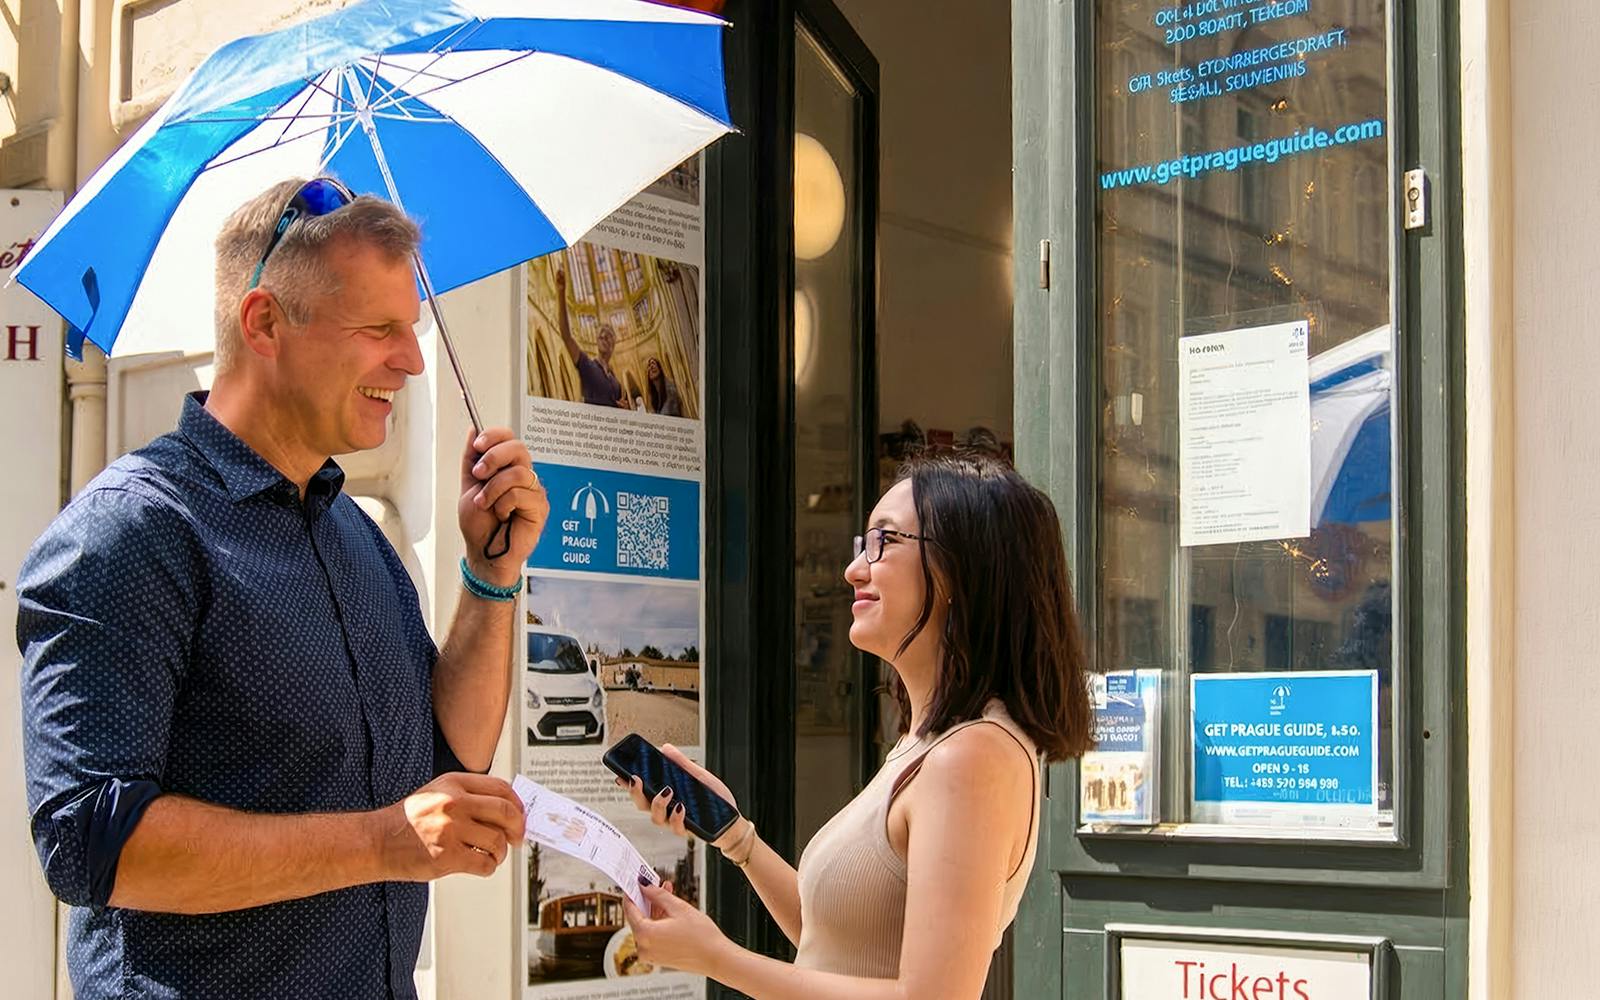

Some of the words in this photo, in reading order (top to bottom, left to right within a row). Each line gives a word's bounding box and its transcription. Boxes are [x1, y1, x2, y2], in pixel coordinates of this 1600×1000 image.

[1101, 119, 1382, 189] www.getpragueguide.com
[6, 325, 41, 361] H
[562, 519, 580, 532] GET
[562, 535, 598, 549] PRAGUE
[1204, 724, 1228, 737] GET
[1230, 724, 1281, 737] PRAGUE
[1283, 724, 1327, 739] GUIDE,
[1205, 745, 1360, 757] WWW.GETPRAGUEGUIDE.COM
[1252, 763, 1280, 774] OPEN
[1175, 960, 1309, 1000] Tickets
